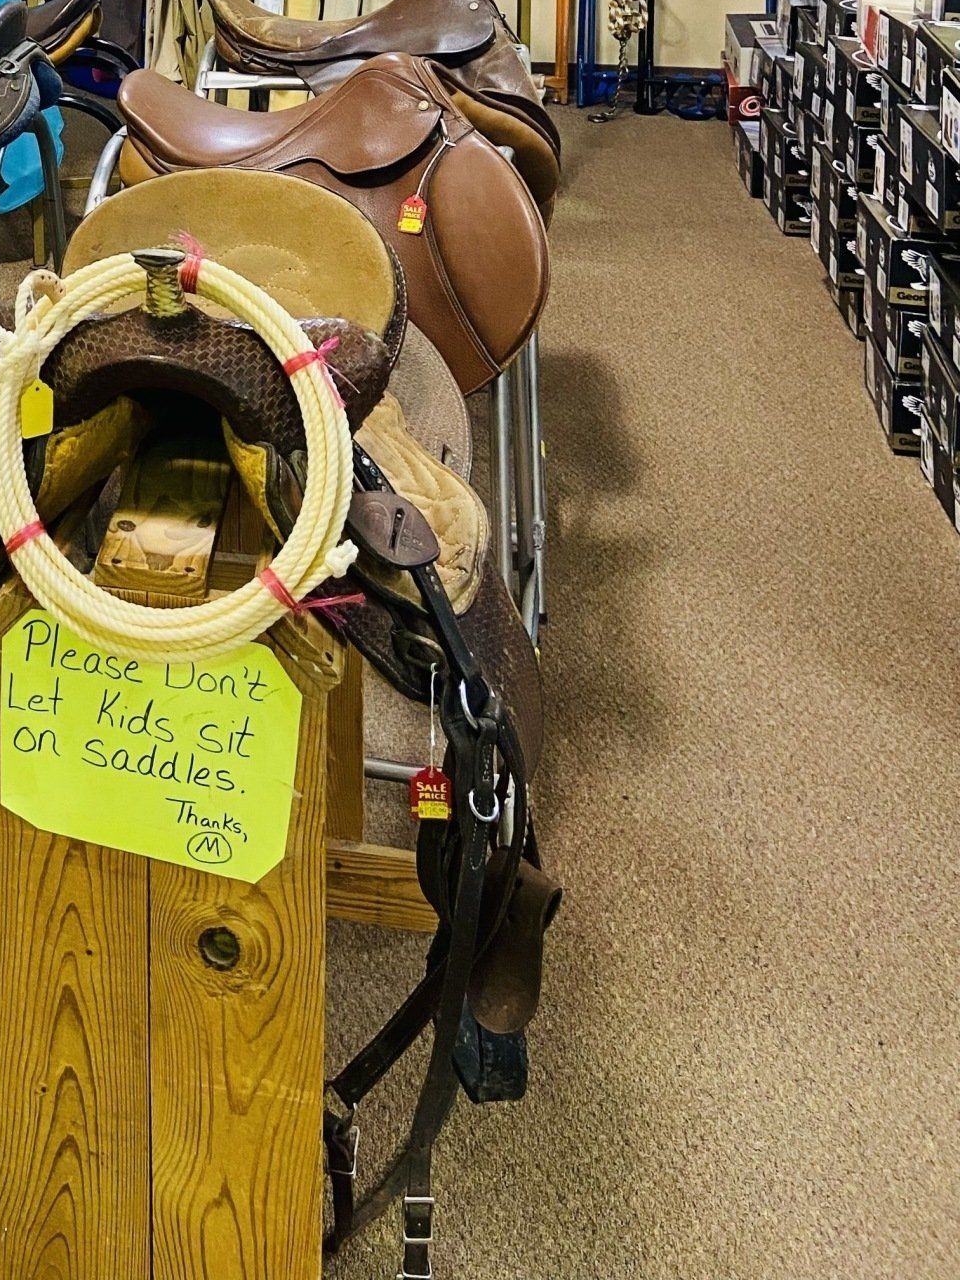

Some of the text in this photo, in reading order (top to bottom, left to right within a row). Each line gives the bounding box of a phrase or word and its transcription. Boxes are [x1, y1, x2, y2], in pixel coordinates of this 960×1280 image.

[403, 205, 423, 213] SALE
[22, 618, 267, 702] Please Don't
[8, 673, 64, 715] Let
[97, 688, 174, 743] Kids
[416, 781, 447, 793] SALE
[419, 793, 446, 801] PRICE
[165, 797, 248, 843] Thanks,
